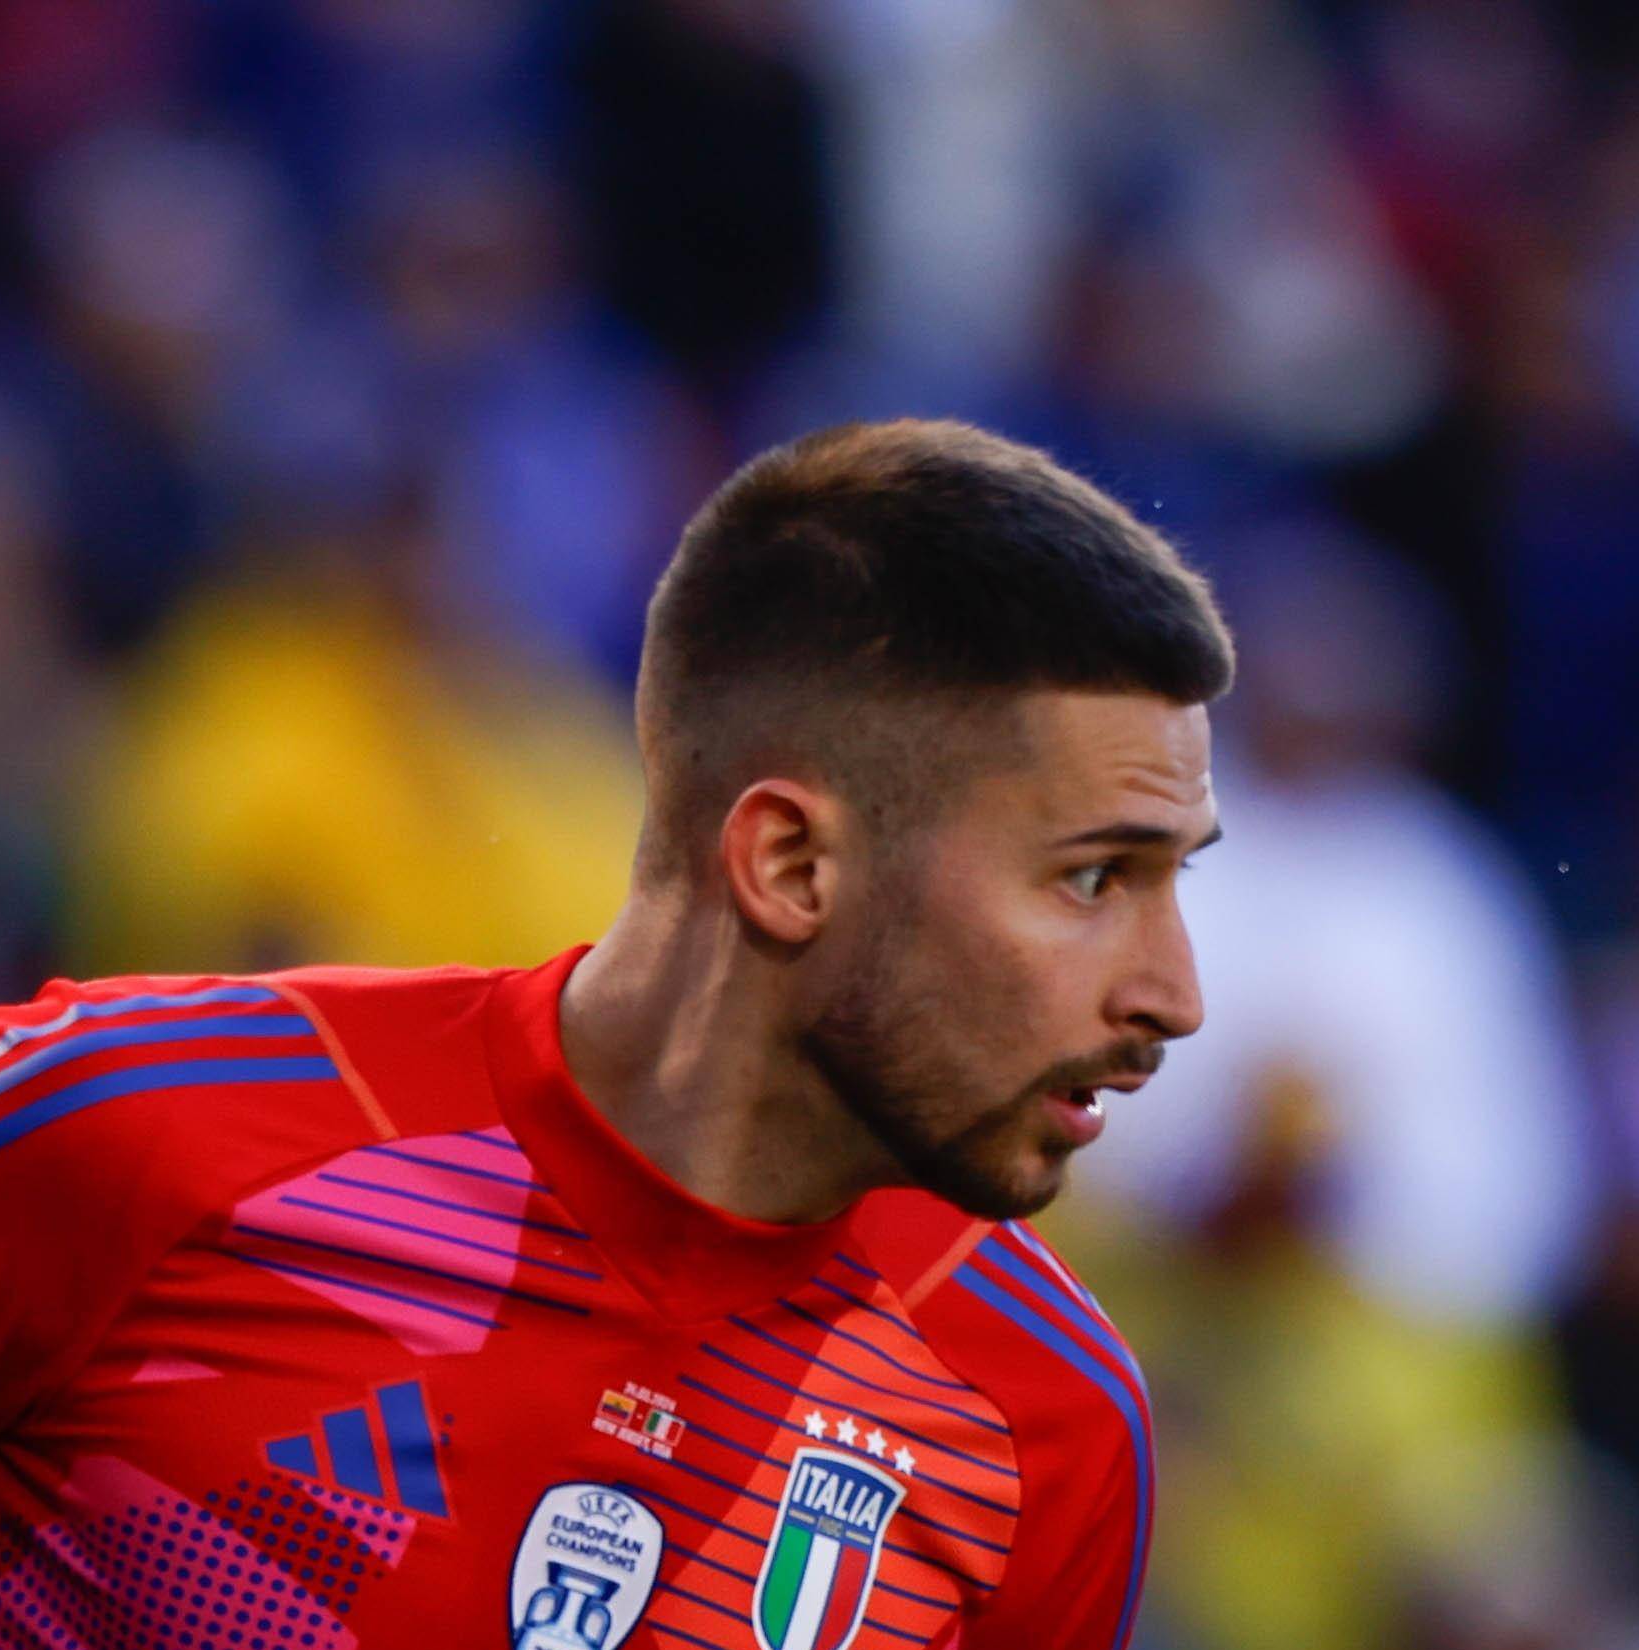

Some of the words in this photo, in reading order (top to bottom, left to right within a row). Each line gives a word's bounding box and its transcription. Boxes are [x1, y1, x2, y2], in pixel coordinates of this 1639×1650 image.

[579, 1494, 632, 1526] UEFA
[791, 1462, 884, 1531] ITALIA
[546, 1532, 637, 1573] CHAMPIONS
[552, 1514, 643, 1554] EUROPEAN
